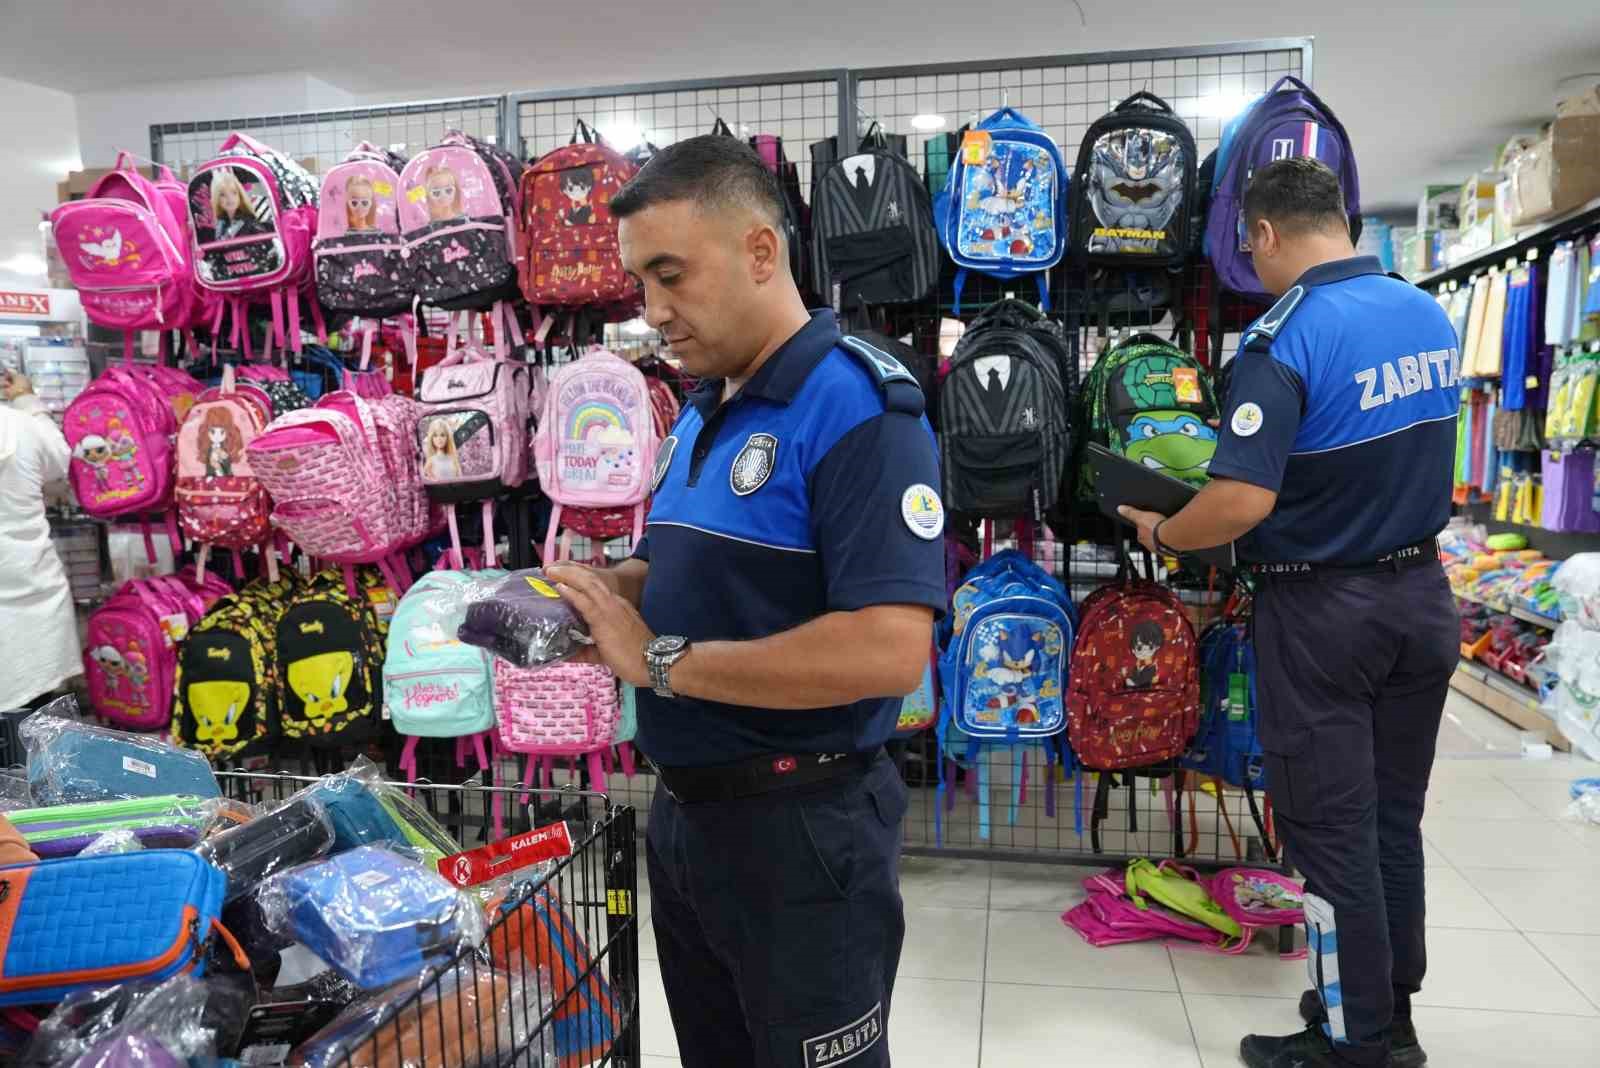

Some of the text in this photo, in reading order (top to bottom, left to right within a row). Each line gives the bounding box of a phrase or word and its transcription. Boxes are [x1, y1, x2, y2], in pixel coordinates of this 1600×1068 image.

[1094, 228, 1166, 240] BATMAN
[565, 456, 599, 468] TODAY
[511, 833, 548, 852] KALEM
[815, 1018, 878, 1063] ZABITA
